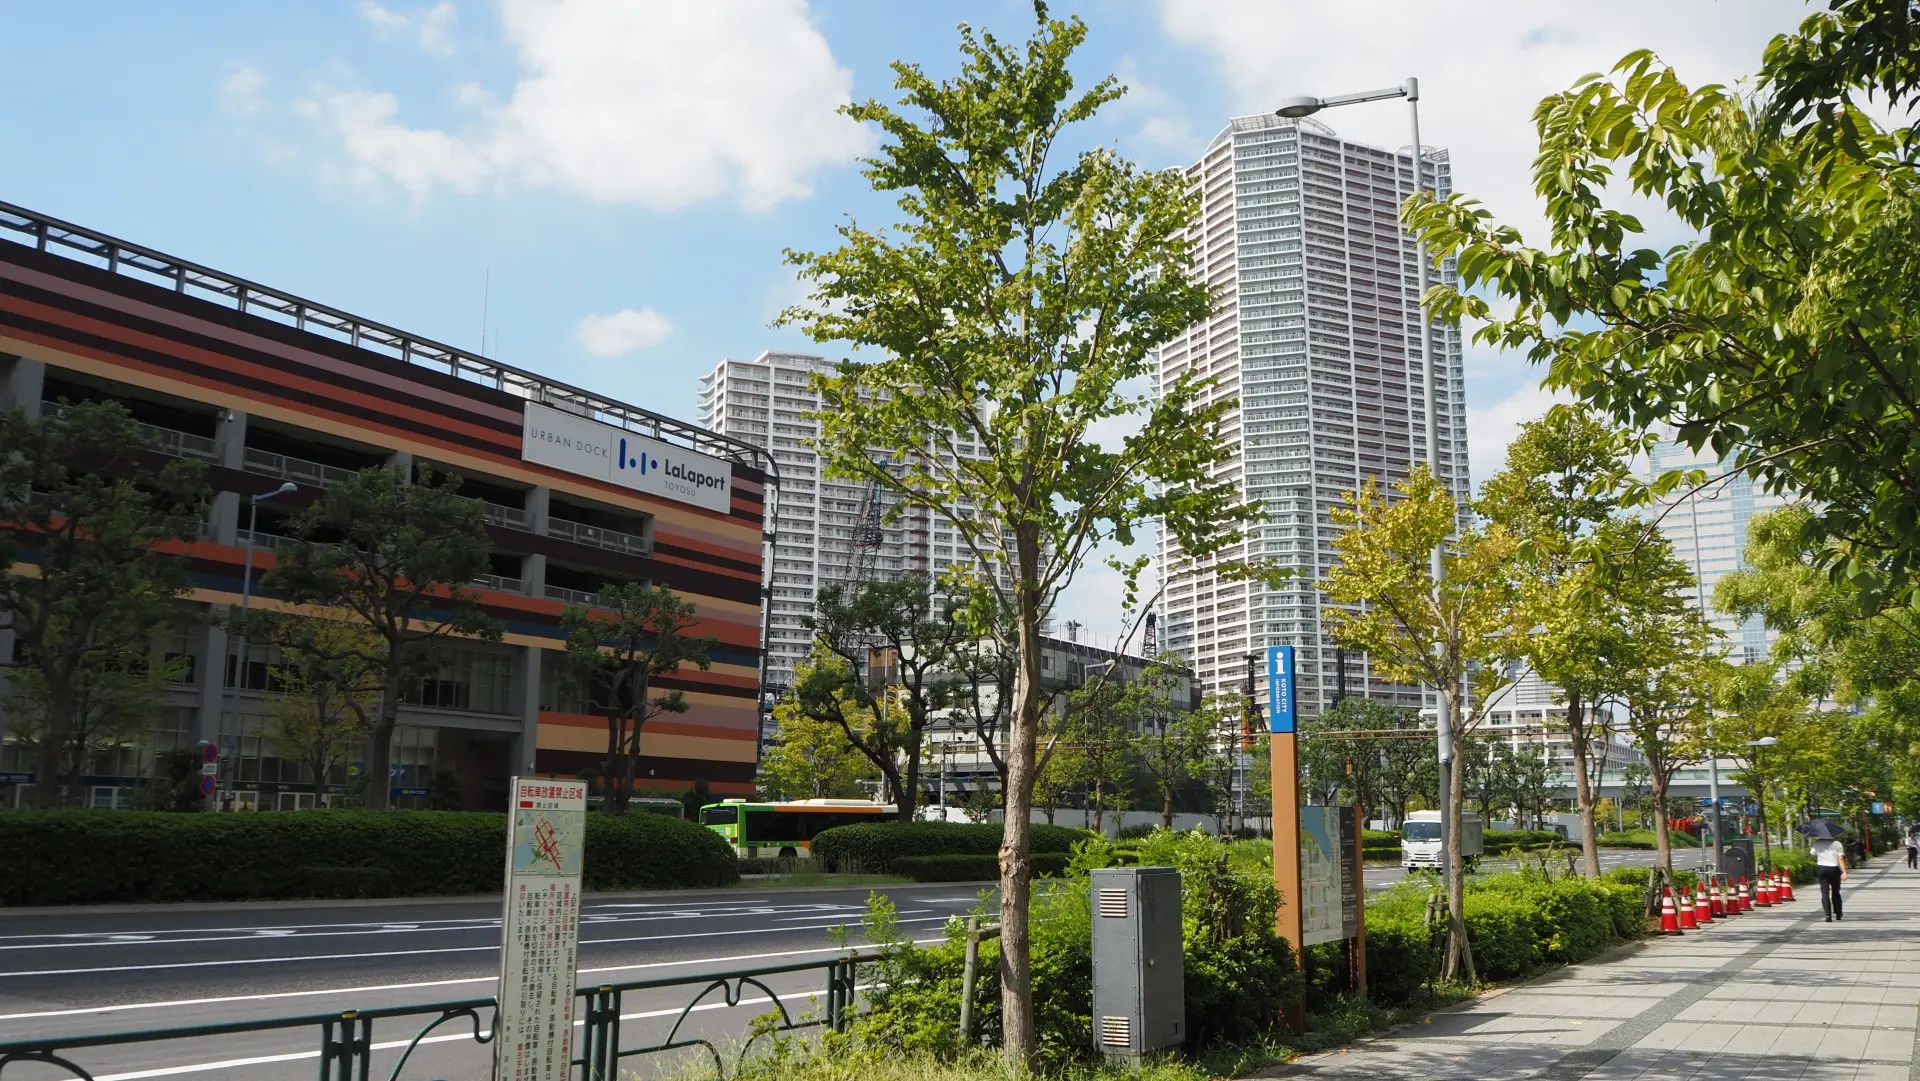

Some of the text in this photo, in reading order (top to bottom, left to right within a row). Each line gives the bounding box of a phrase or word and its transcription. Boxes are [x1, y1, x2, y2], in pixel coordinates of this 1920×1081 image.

[531, 428, 608, 458] URBAN DOCK
[664, 458, 725, 491] LaLaport
[664, 480, 696, 497] TOYOSU
[520, 785, 583, 800] 自転車放置禁止区域
